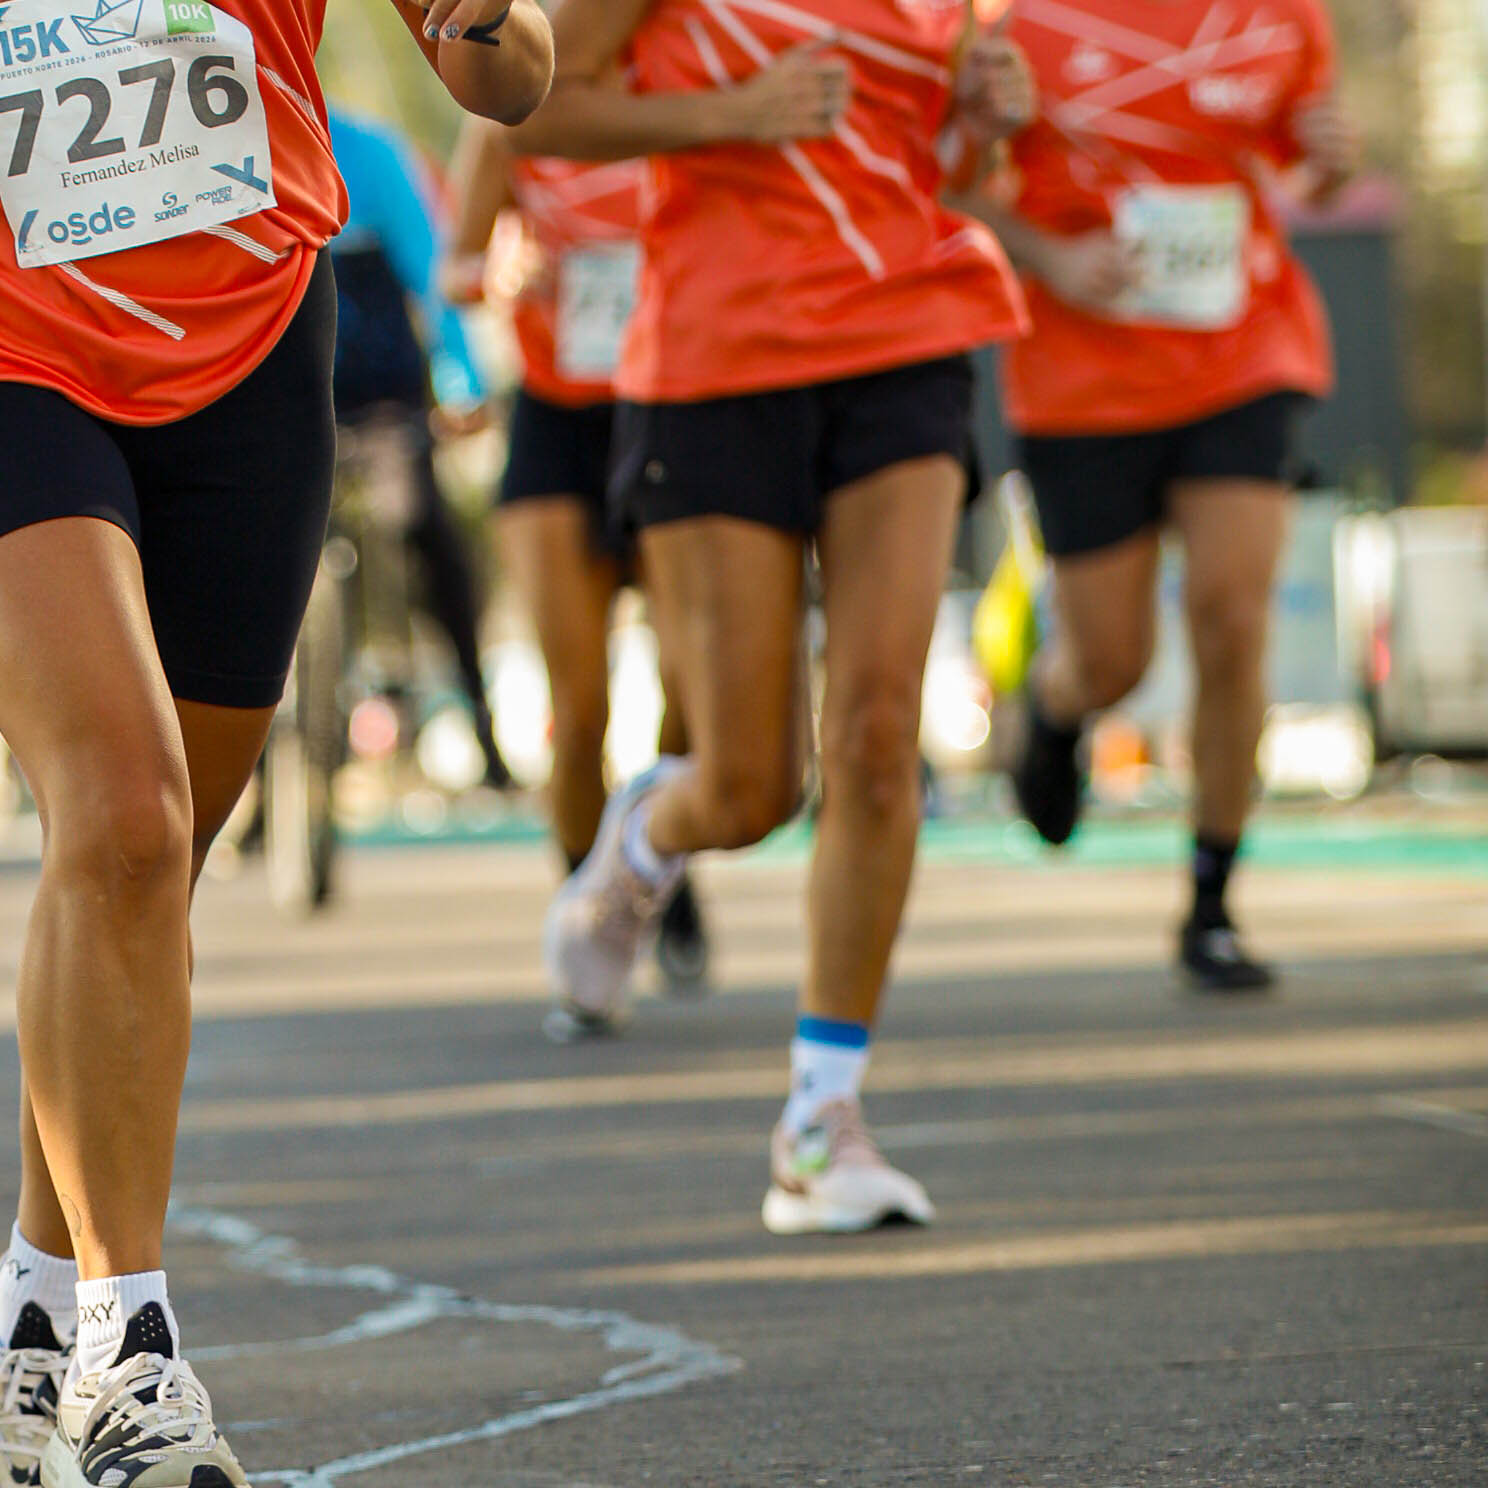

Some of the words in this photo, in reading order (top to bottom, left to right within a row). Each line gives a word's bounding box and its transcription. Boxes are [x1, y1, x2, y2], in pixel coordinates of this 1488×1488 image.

[168, 3, 209, 21] 10K
[0, 67, 33, 80] PUERTO
[35, 61, 62, 73] NORTE
[95, 45, 132, 59] ROSARIO
[167, 35, 193, 44] ABRIL
[61, 156, 147, 188] Fernandez
[151, 143, 200, 169] Melisa
[48, 202, 136, 245] osde
